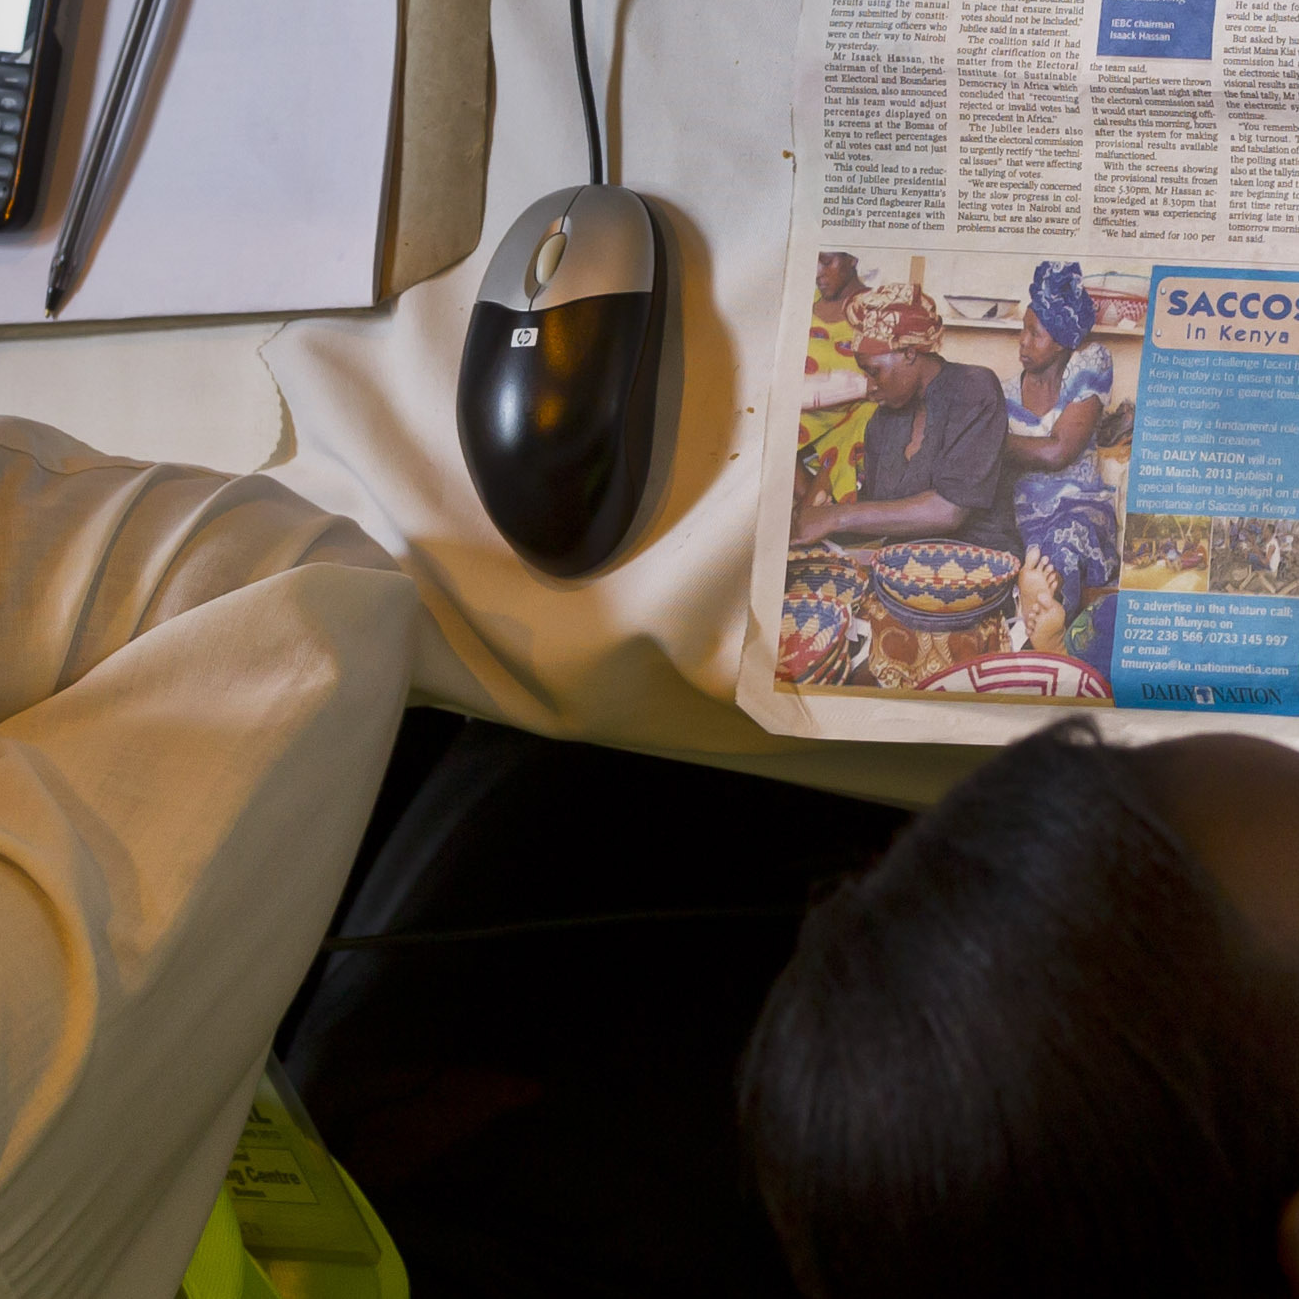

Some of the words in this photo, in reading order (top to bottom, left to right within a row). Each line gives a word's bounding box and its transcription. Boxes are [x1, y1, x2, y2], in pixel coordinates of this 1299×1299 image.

[1111, 19, 1132, 27] IEBC
[1134, 19, 1175, 29] chairman
[1110, 31, 1136, 40] Isaack
[1139, 31, 1170, 41] Hassan
[824, 130, 851, 139] Kenya
[854, 130, 862, 138] to
[866, 131, 892, 139] reflect
[896, 133, 947, 143] percentages
[824, 140, 833, 149] of
[836, 141, 846, 149] all
[849, 142, 871, 150] votes
[874, 143, 892, 151] cast
[895, 143, 911, 151] and
[914, 144, 928, 152] not
[931, 145, 947, 154] just
[1219, 325, 1289, 346] Kenya
[1163, 450, 1196, 462] DAILY
[1199, 452, 1245, 464] NATION
[1139, 465, 1162, 476] 20th
[1205, 468, 1232, 479] 2013
[1128, 600, 1139, 611] To
[1143, 601, 1192, 613] advertise
[1196, 603, 1205, 613] in
[1209, 604, 1225, 614] the
[1229, 604, 1267, 616] feature
[1126, 614, 1171, 627] Teresiah
[1174, 616, 1216, 630] Munyao
[1219, 619, 1233, 629] on
[1124, 629, 1153, 640] 0722
[1157, 630, 1178, 641] 236
[1241, 633, 1262, 645] 145
[1266, 635, 1288, 646] 997
[1123, 645, 1134, 654] or
[1141, 682, 1197, 701] DAILY
[1211, 685, 1282, 706] NATION
